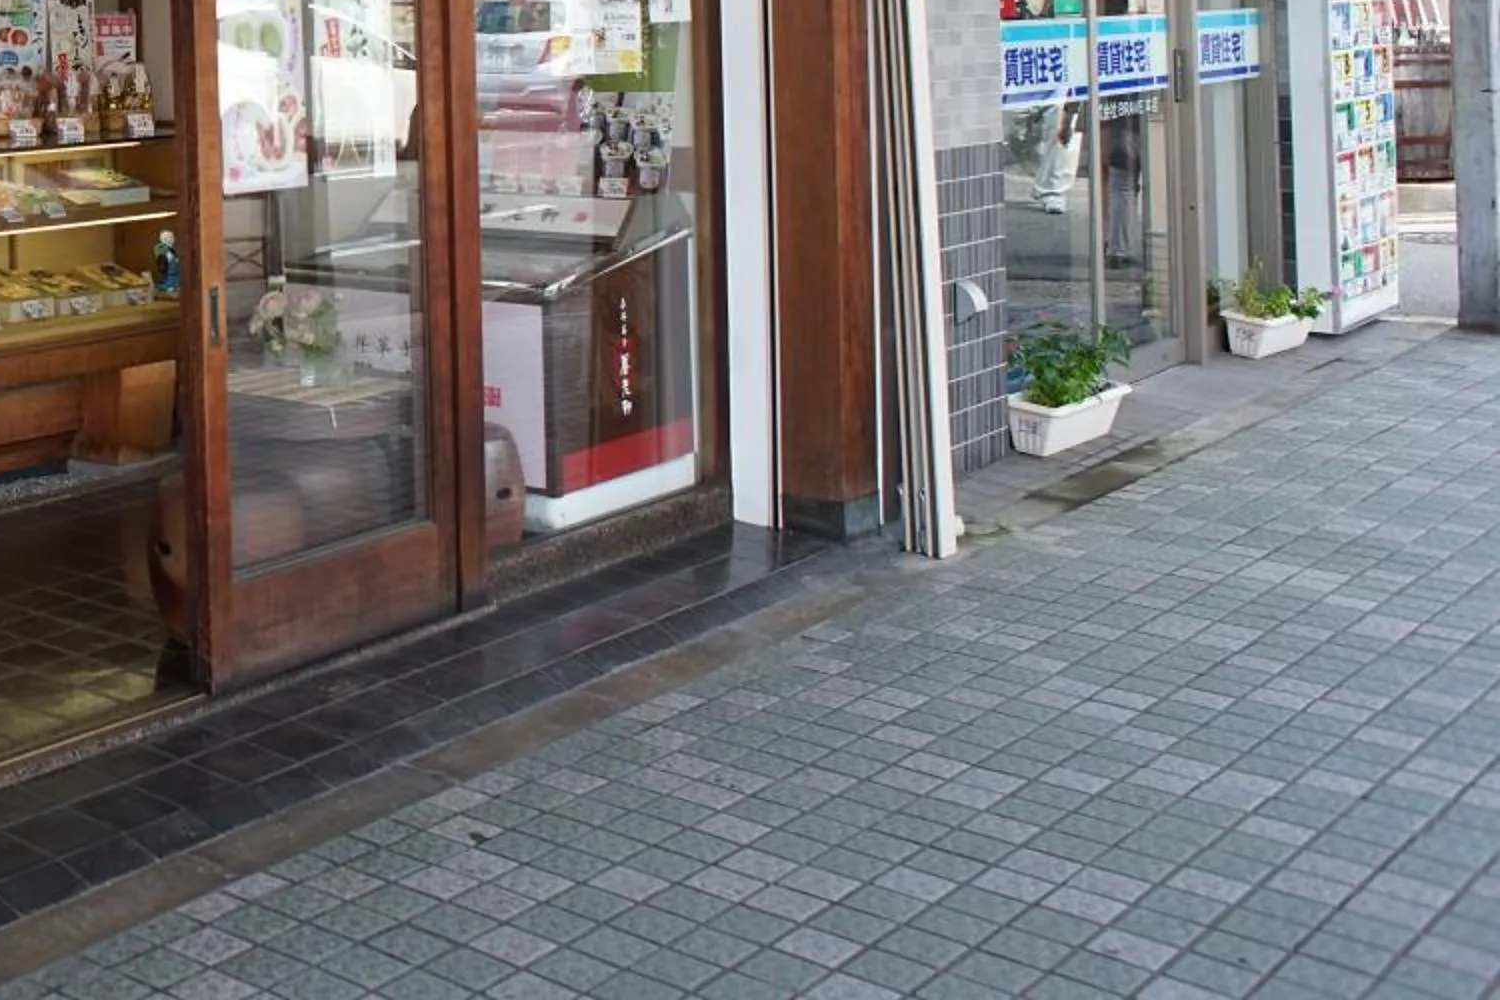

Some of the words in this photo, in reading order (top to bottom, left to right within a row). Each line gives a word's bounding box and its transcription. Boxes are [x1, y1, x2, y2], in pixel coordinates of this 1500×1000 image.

[1003, 44, 1063, 88] 賃貸住宅
[1096, 40, 1147, 76] 賃貸住宅
[1199, 32, 1241, 66] 賃貸住宅
